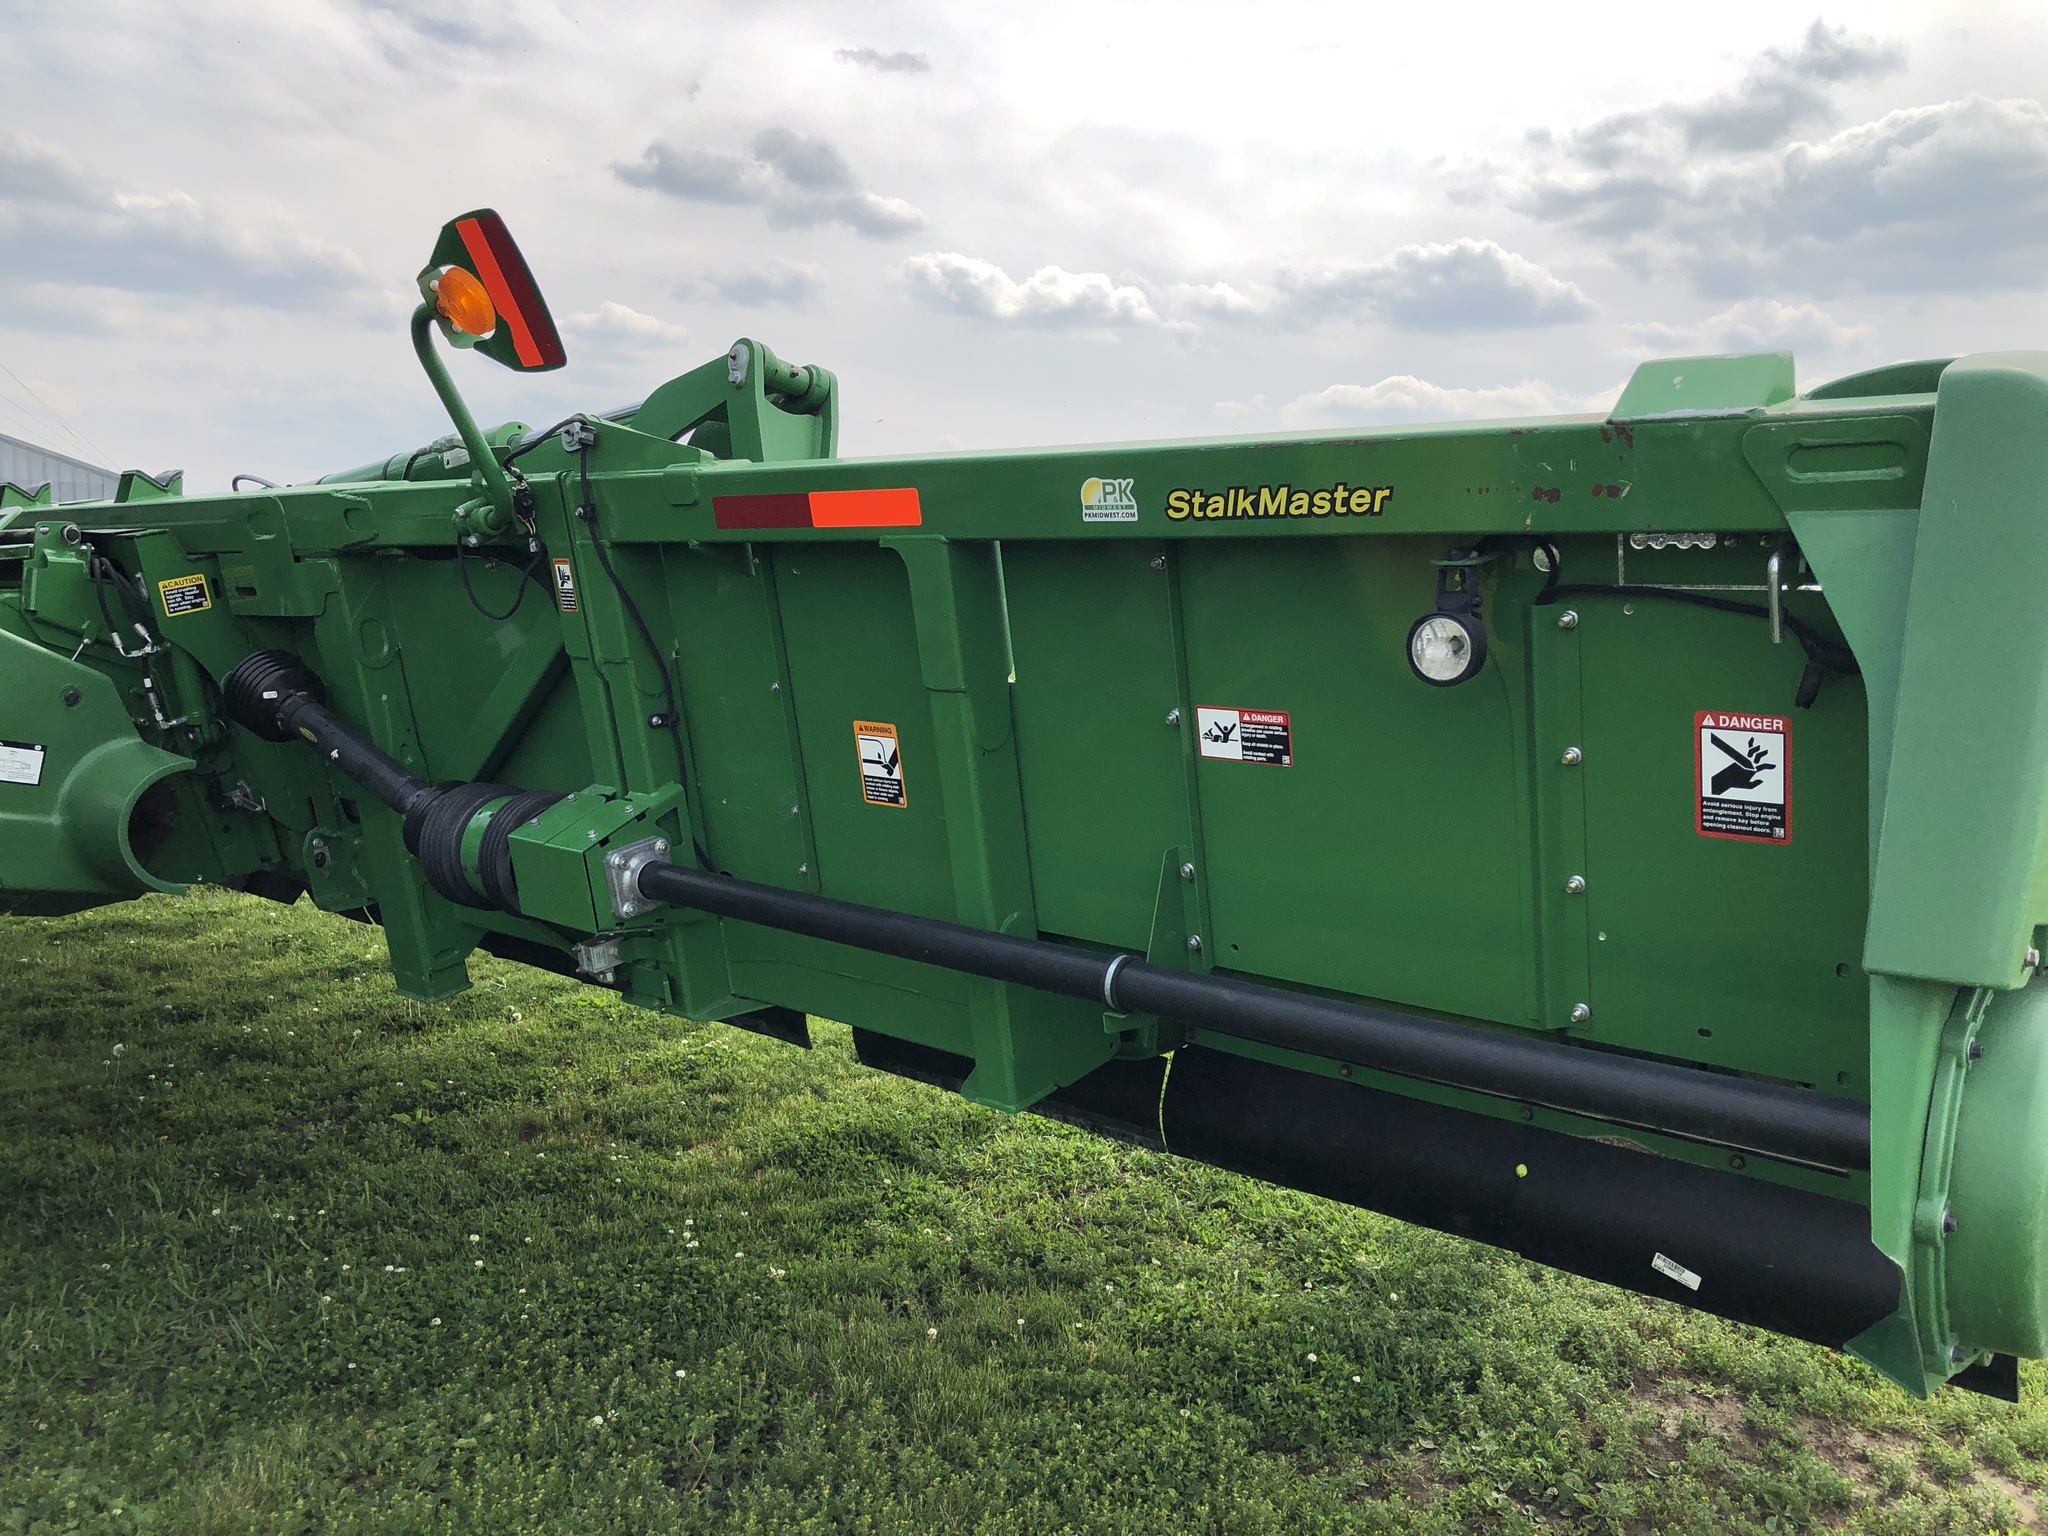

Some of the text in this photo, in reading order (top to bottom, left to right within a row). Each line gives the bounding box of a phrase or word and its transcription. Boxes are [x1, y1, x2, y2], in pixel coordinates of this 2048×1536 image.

[1166, 484, 1391, 519] StalkMaster
[168, 576, 202, 588] CAUTION
[1252, 714, 1284, 723] DANGER
[1719, 716, 1783, 730] DANGER
[863, 725, 892, 734] WARNING
[1702, 808, 1743, 816] entanglement.
